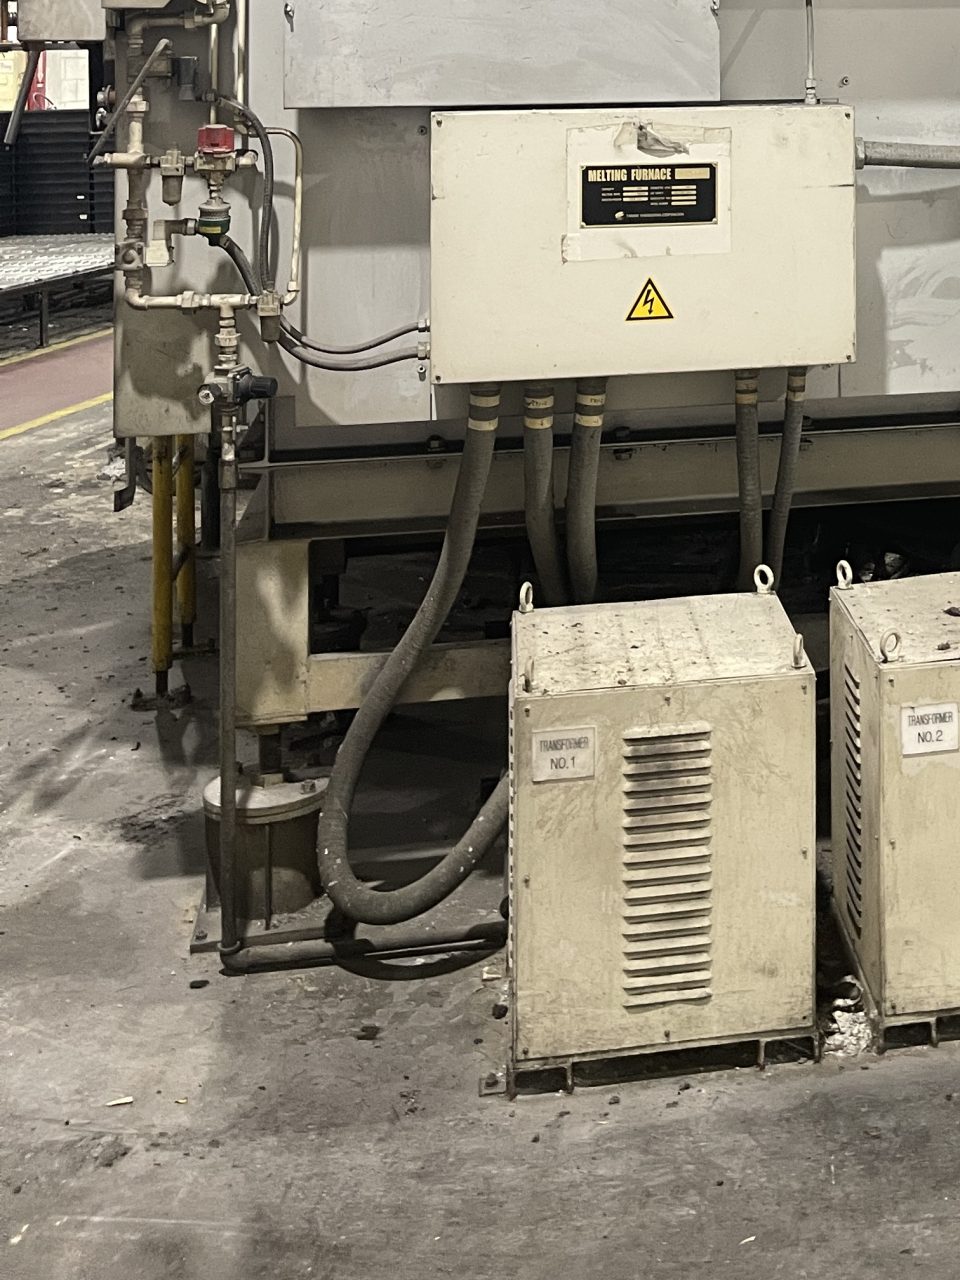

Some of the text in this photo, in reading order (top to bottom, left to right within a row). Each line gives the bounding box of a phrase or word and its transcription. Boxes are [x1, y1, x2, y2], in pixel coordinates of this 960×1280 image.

[588, 167, 672, 182] MELTING FURNACE
[908, 711, 953, 726] TRANSFORMER
[540, 736, 589, 752] TRANSFORMER
